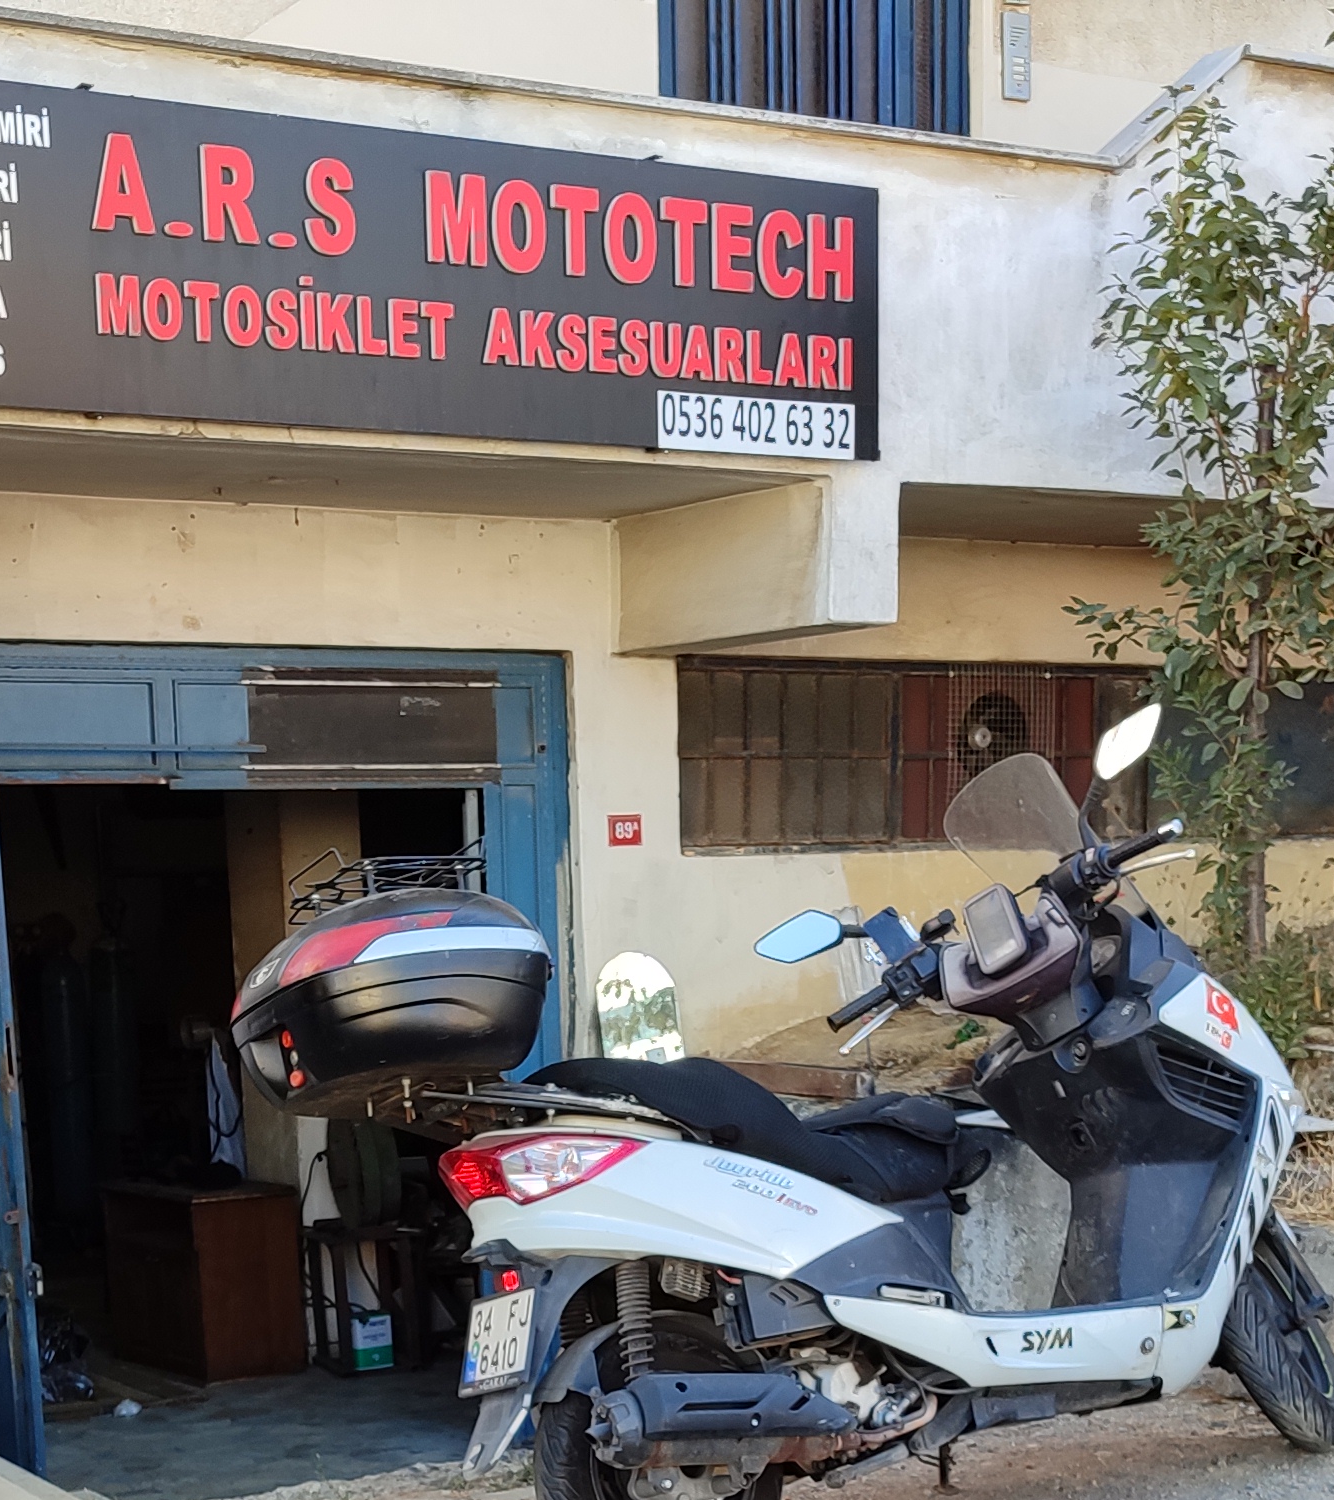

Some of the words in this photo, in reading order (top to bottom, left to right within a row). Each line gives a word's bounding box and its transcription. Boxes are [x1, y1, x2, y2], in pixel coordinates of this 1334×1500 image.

[91, 132, 357, 256] A.R.S
[424, 169, 855, 302] MOTOTECH
[96, 272, 454, 360] MOTOSİKLET
[483, 307, 853, 391] AKSESUARLARI
[662, 394, 724, 440] 0536
[732, 400, 776, 444] 402
[786, 405, 813, 446] 63
[823, 408, 851, 450] 32
[473, 1306, 494, 1340] 34
[507, 1294, 531, 1331] FJ
[1021, 1326, 1073, 1354] SYM
[479, 1336, 518, 1375] 6410
